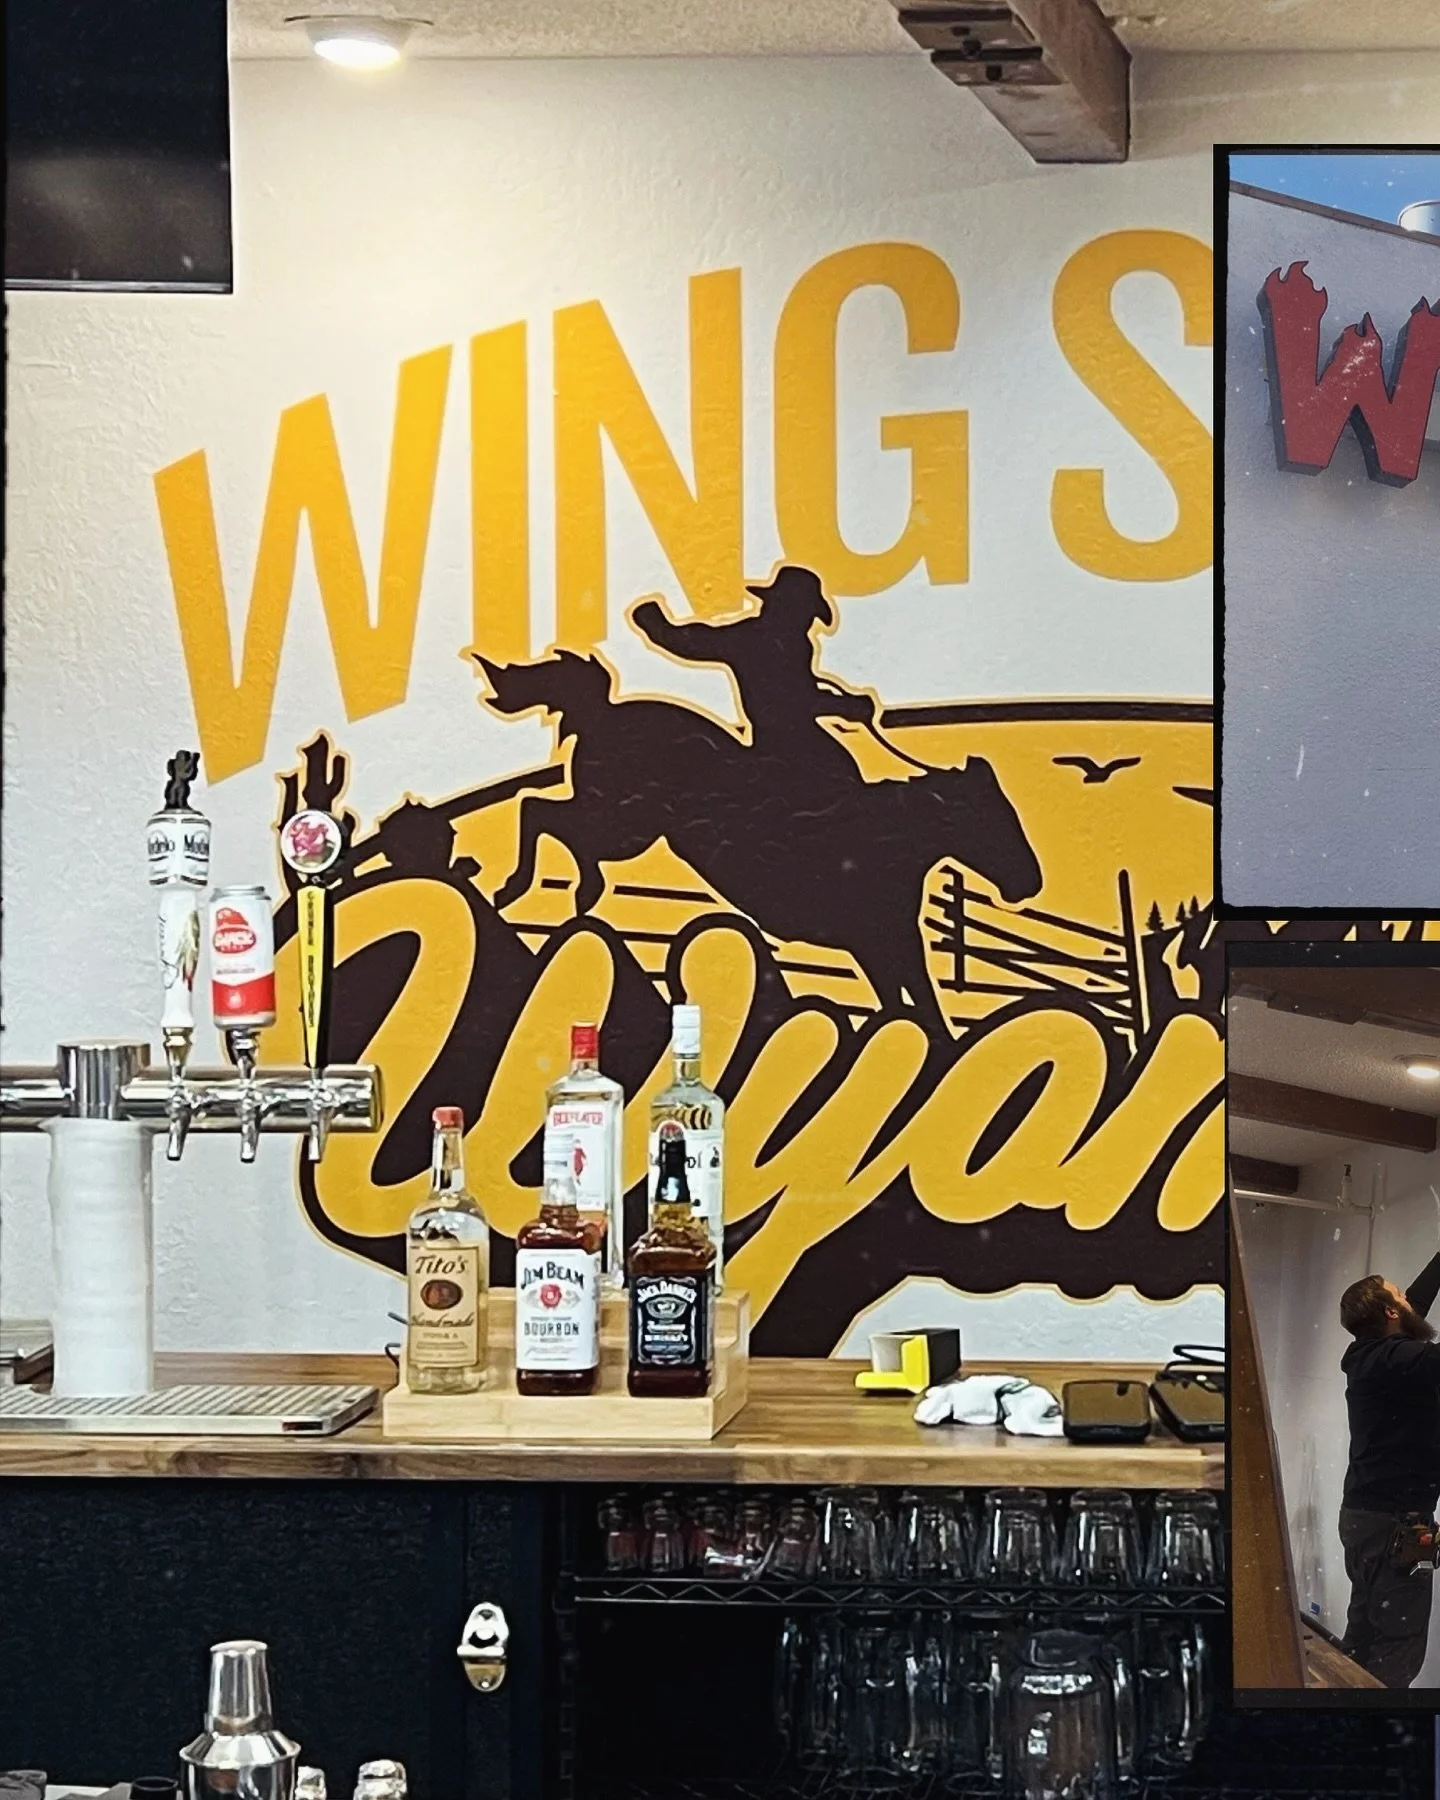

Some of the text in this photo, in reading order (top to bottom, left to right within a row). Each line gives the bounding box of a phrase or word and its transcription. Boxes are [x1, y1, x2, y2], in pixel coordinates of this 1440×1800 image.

[1256, 260, 1440, 489] W
[153, 241, 970, 786] WING
[415, 1254, 469, 1275] Tito's
[520, 1260, 585, 1290] JIM BEAM
[524, 1321, 580, 1336] BOURBON
